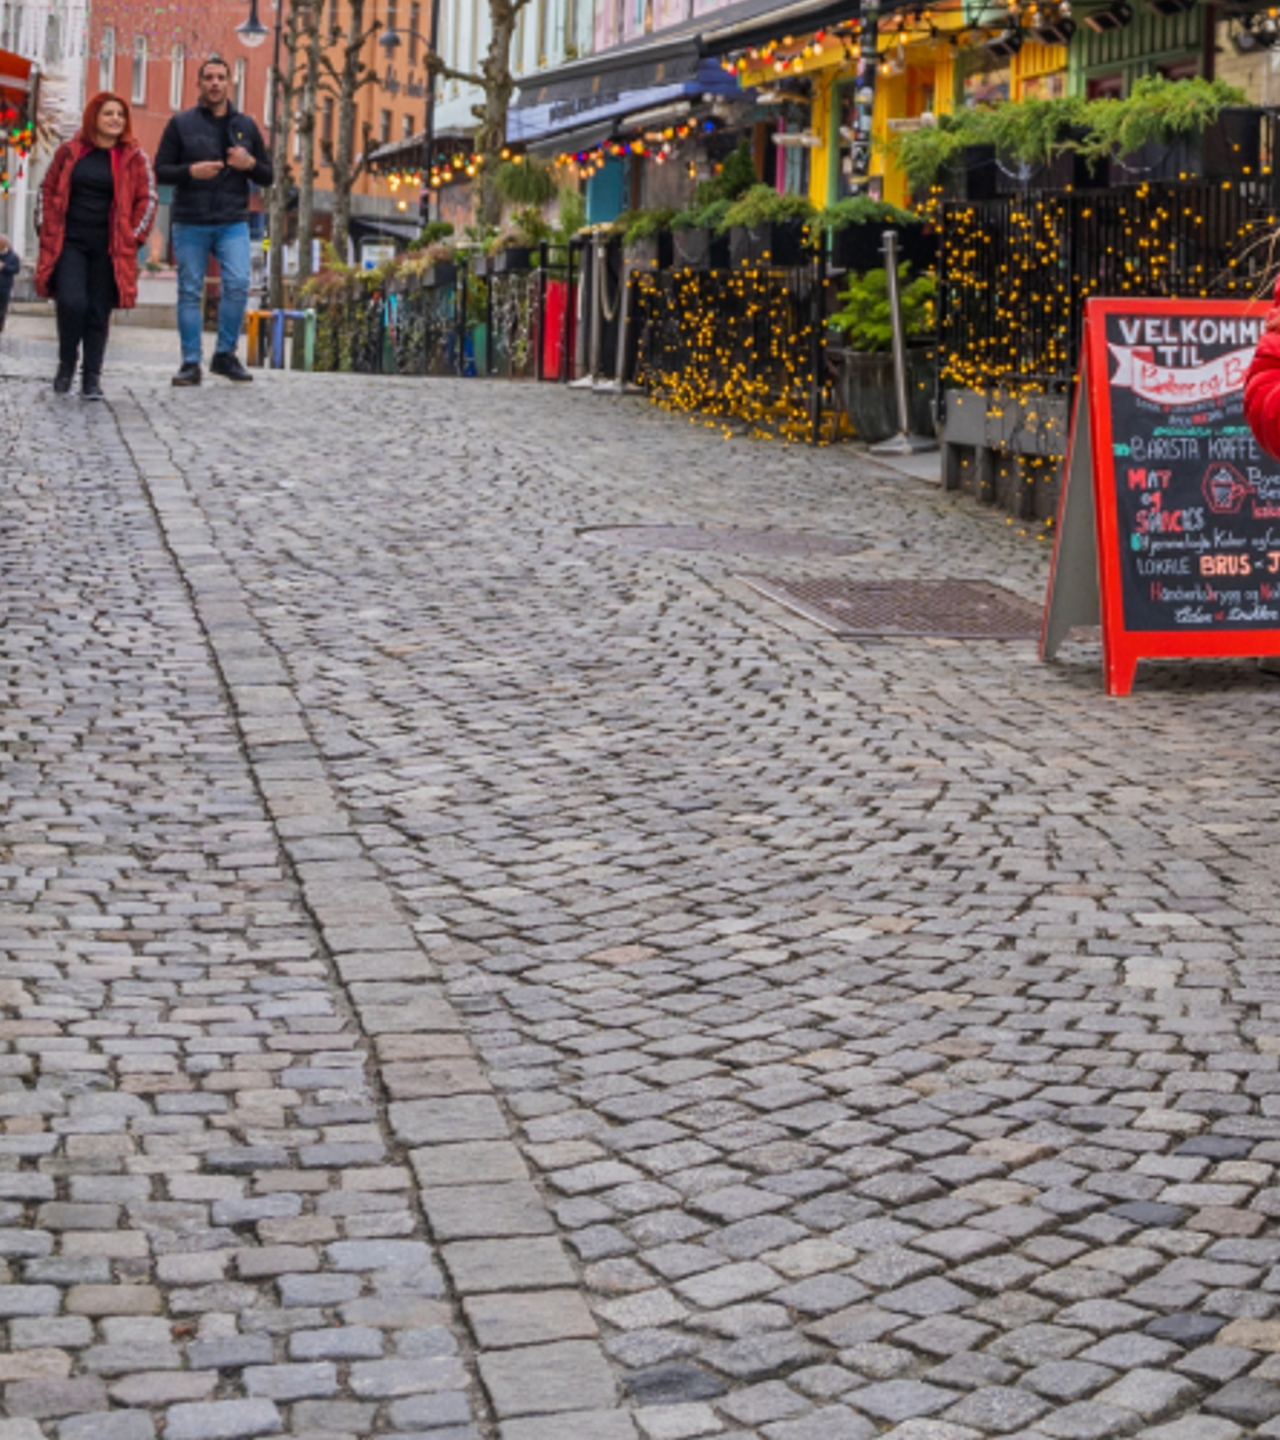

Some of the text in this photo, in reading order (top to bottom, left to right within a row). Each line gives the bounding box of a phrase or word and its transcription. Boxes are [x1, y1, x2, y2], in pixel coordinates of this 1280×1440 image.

[1157, 345, 1204, 366] TIL
[1130, 435, 1260, 461] BARISTA KAFFE
[1127, 468, 1172, 490] MAT
[1140, 491, 1163, 513] og
[1135, 506, 1205, 534] SNACKS
[1199, 553, 1252, 577] BRUS
